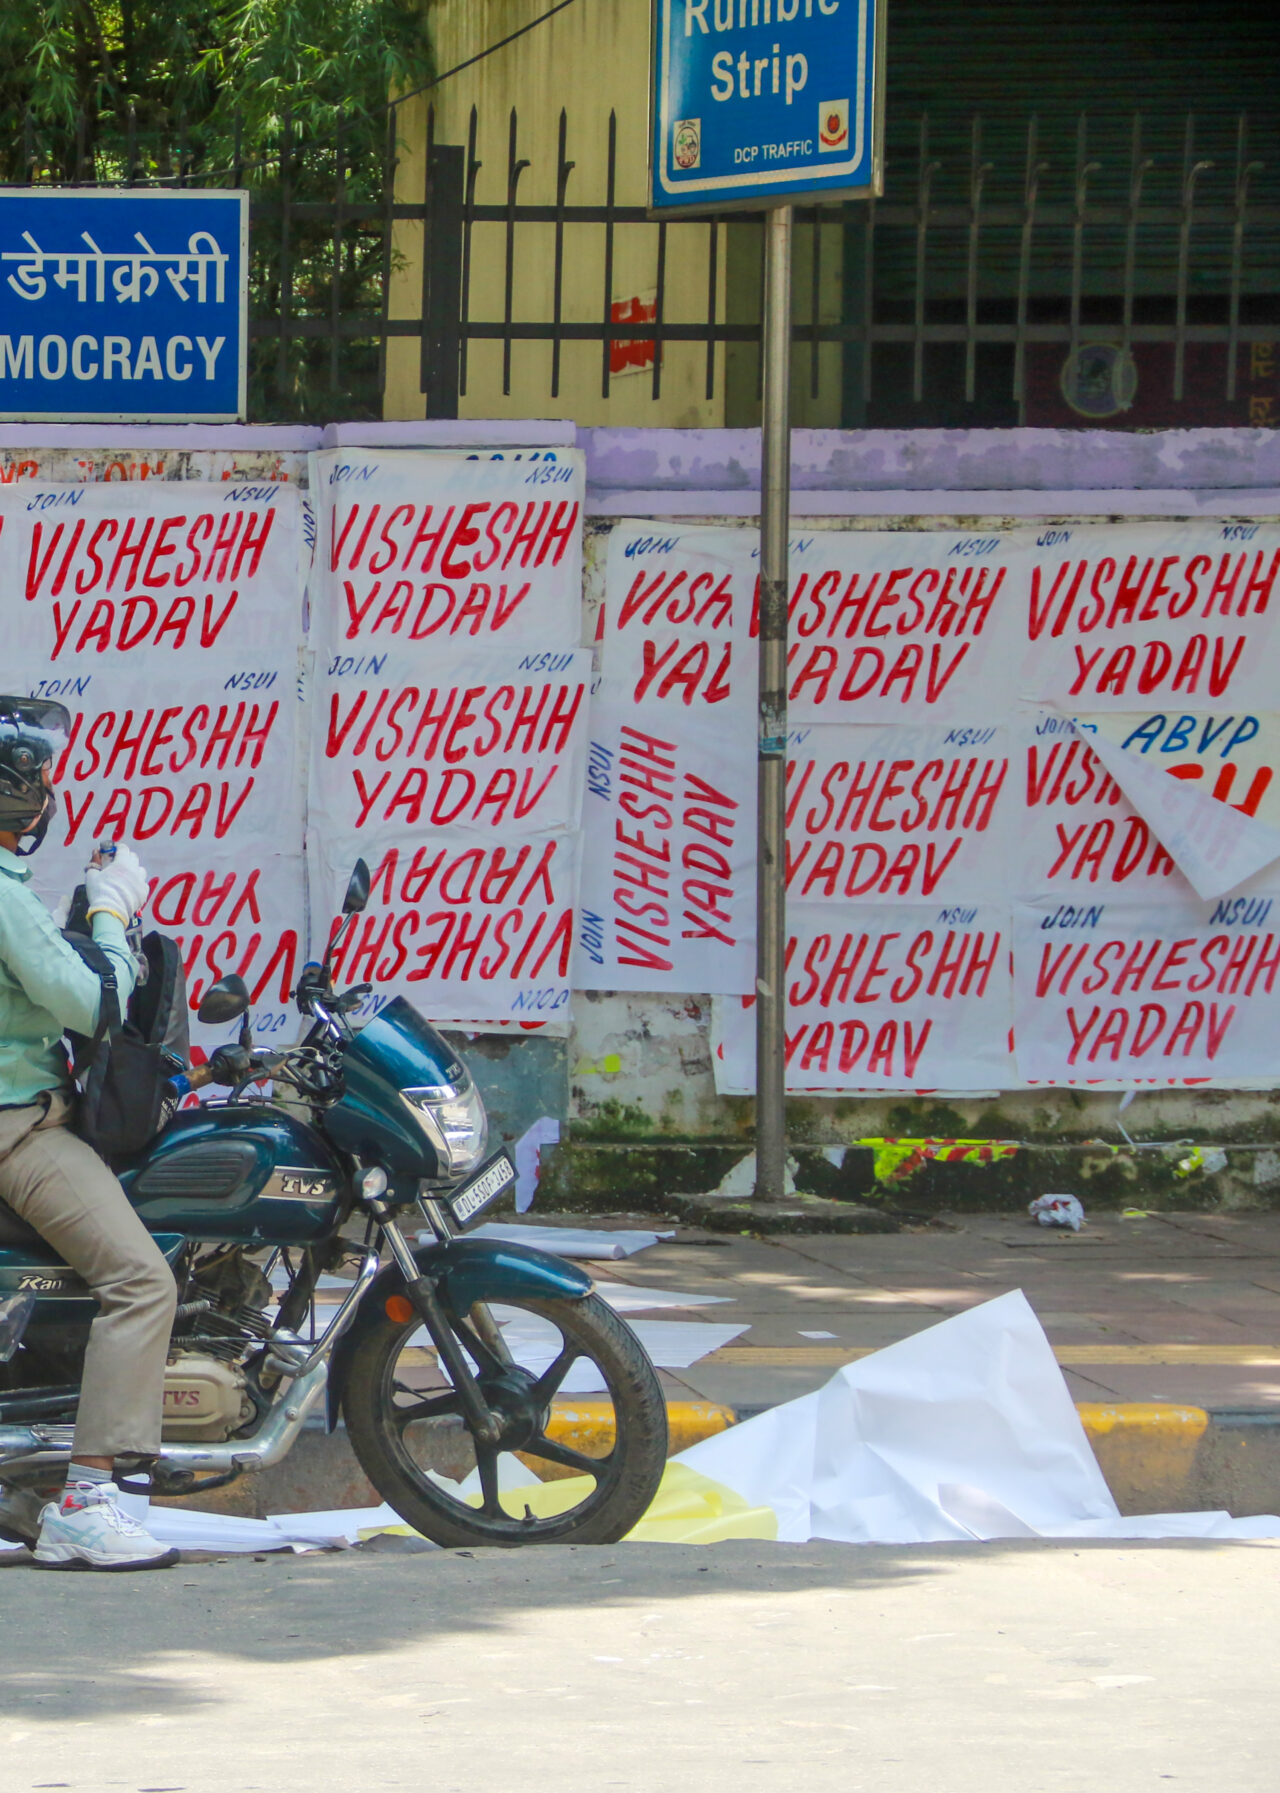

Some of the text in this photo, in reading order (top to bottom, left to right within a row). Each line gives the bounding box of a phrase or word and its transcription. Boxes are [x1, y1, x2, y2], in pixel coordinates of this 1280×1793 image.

[711, 43, 808, 106] Strip
[734, 139, 813, 164] DCP TRAFFIC
[2, 231, 229, 304] डेमोक्रेसी
[26, 486, 280, 512] JOIN NSUI
[329, 464, 574, 484] JOIN NSUI
[25, 508, 276, 600] VISHESHH
[330, 499, 580, 580] VISHESHH
[625, 537, 680, 560] JOIN
[949, 540, 1000, 557] NSUI
[1037, 525, 1259, 546] JOIN NSUI
[343, 580, 531, 641] YADAV
[1027, 548, 1280, 641] VISHESHH
[50, 590, 239, 661] YADAV
[31, 675, 91, 698] JOIN
[223, 671, 278, 691] NSUI
[328, 653, 573, 677] JOIN NSUI
[1068, 633, 1248, 698] YADAV
[52, 700, 279, 785] ISHESHH
[324, 682, 585, 765] VISHESHH
[945, 727, 996, 746] NSUI
[1121, 714, 1260, 758] ABVP
[352, 764, 559, 829] YADAV
[588, 741, 615, 802] NSUI
[63, 776, 254, 847] YADAV
[370, 840, 557, 905] YADAV
[613, 725, 680, 972] VISHESHH
[681, 772, 740, 947] YADAV
[137, 868, 261, 927] YAD
[937, 906, 979, 925] NSUI
[1041, 898, 1272, 930] JOIN NSUI
[579, 908, 605, 965] JOIN
[1035, 932, 1280, 1000] VISHESHH
[1065, 1001, 1237, 1066] YADAV
[284, 1175, 326, 1195] TVS
[163, 1391, 200, 1405] TVS
